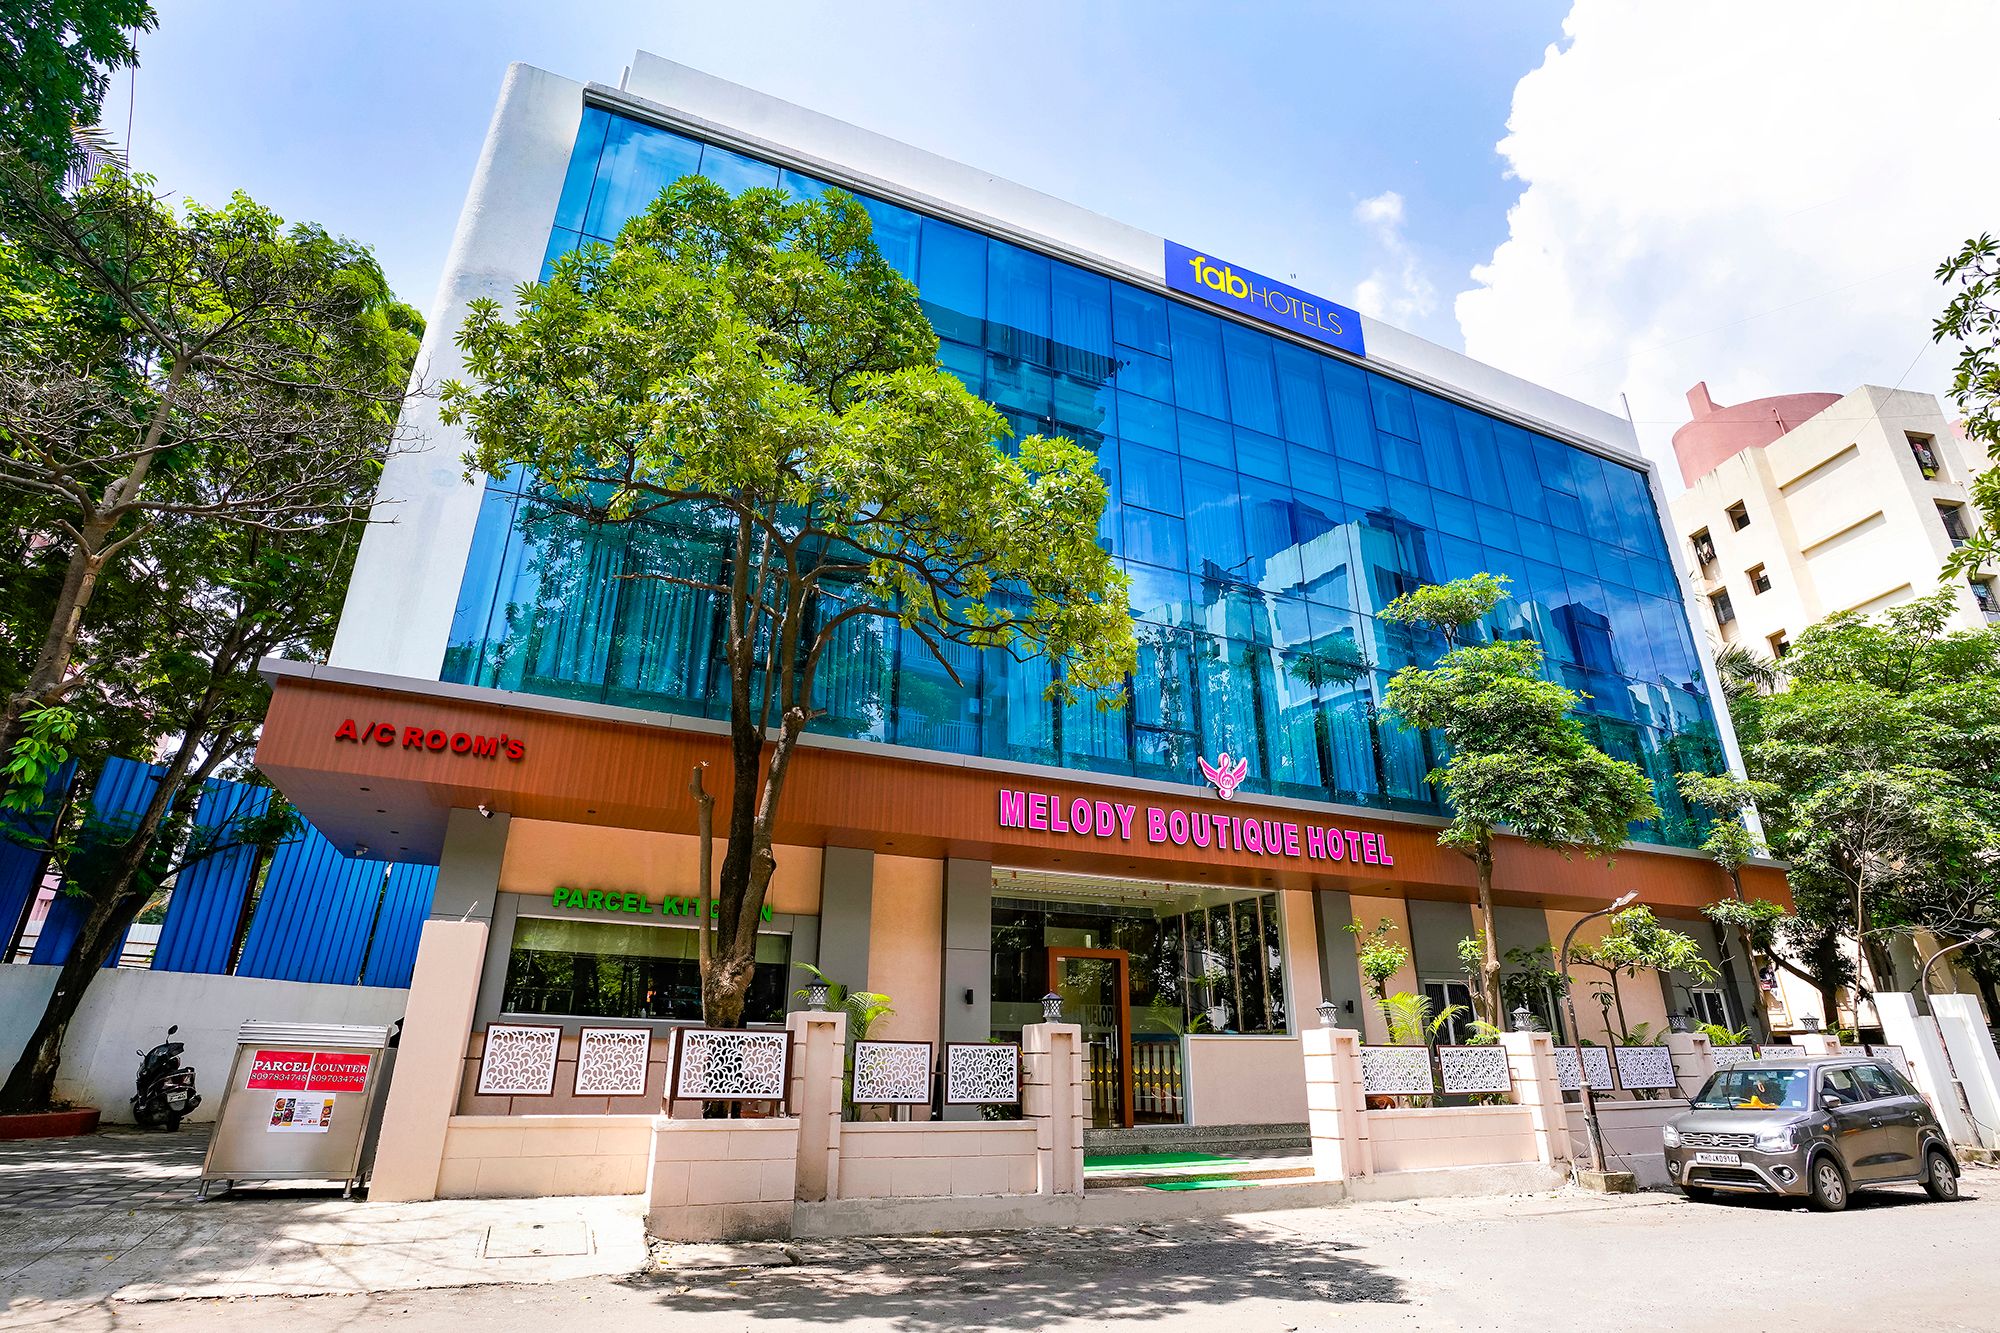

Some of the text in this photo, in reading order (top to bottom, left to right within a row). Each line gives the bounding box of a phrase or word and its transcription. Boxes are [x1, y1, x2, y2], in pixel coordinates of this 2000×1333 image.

[1188, 255, 1343, 335] fabHOTELS
[334, 718, 525, 760] A/C ROOM'S
[999, 788, 1394, 866] MELODY BOUTIQUE HOTEL
[552, 887, 653, 914] PARCEL
[253, 1060, 367, 1074] PARCEL COUNTER
